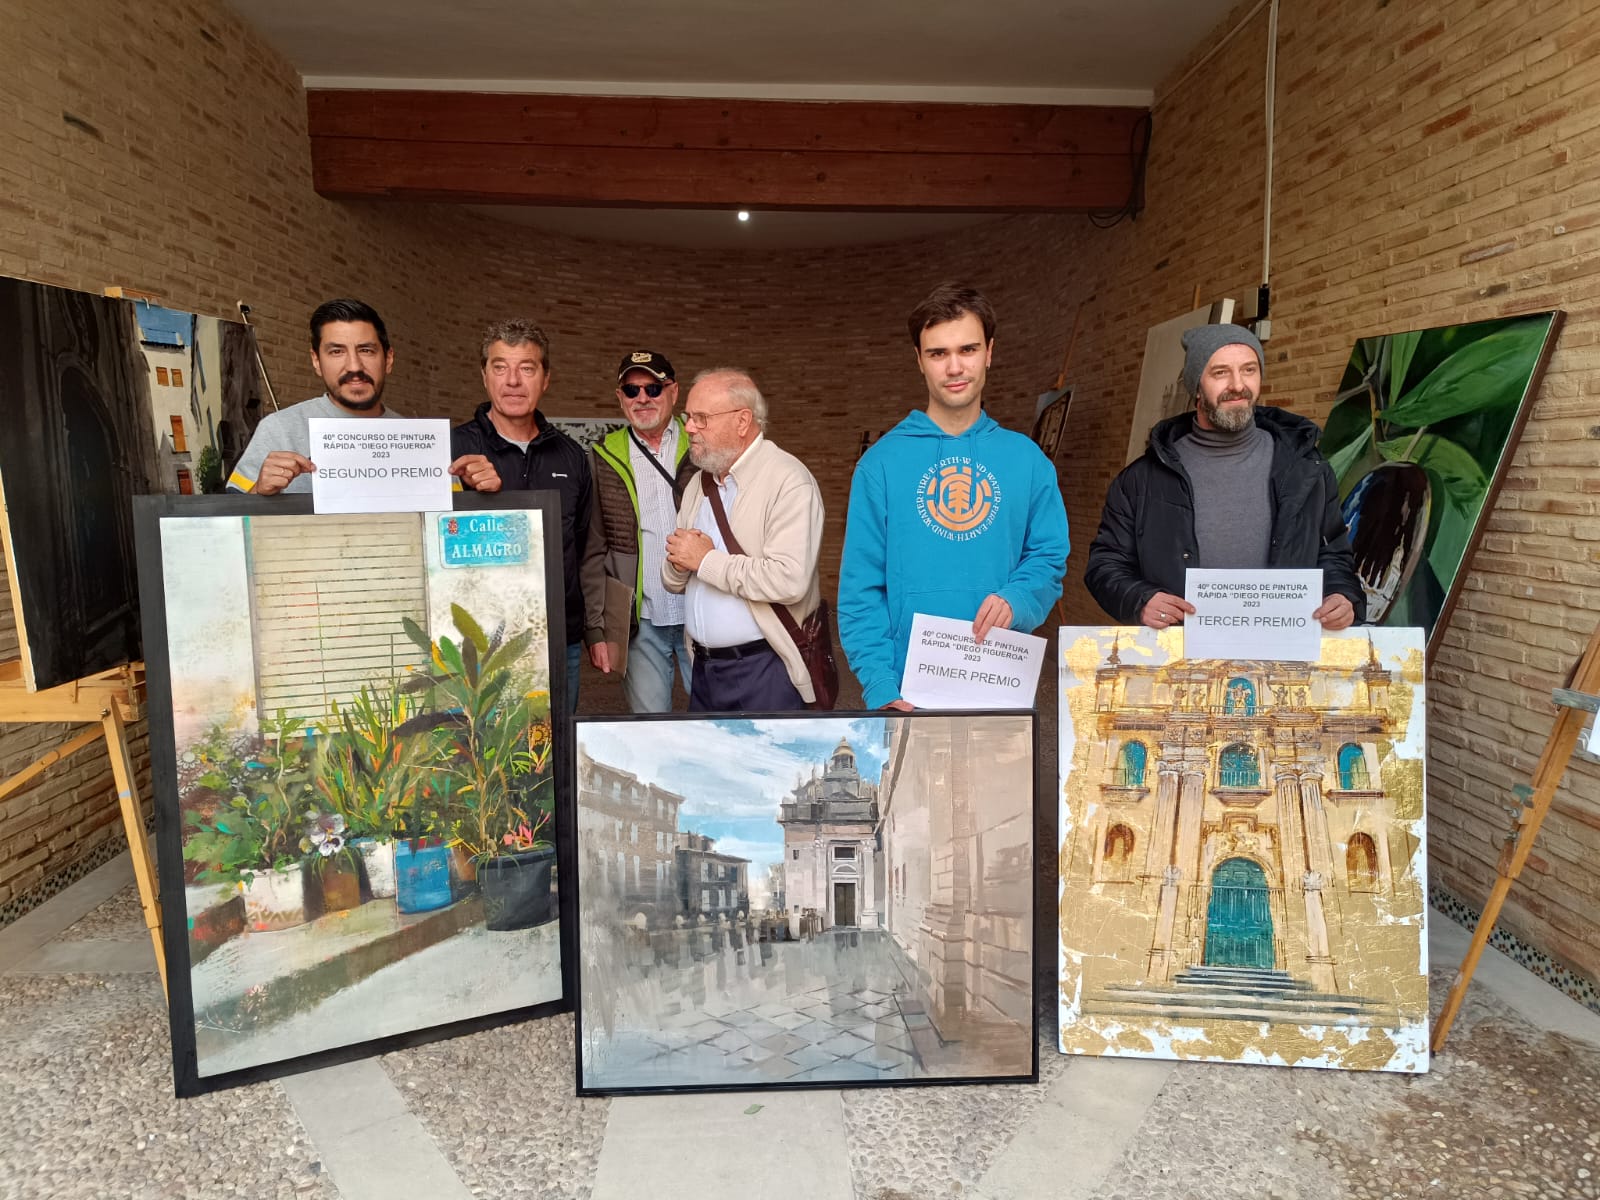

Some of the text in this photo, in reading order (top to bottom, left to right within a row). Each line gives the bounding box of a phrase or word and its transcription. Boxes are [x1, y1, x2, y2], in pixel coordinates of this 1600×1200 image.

[337, 433, 386, 441] CONCURSO
[387, 433, 398, 441] DE
[401, 433, 436, 441] PINTURA
[323, 442, 355, 450] RÁPIDA
[319, 467, 443, 479] SEGUNDO PREMIO
[962, 457, 987, 473] WND
[916, 472, 931, 494] FIRE
[987, 472, 1002, 503] WATER
[916, 496, 932, 527] WATER
[988, 505, 1000, 527] FIRE
[469, 518, 503, 532] Calle
[931, 524, 954, 541] WIND
[957, 524, 988, 541] EARTH
[452, 543, 522, 559] ALMAGRO
[1197, 615, 1306, 628] TERCER PREMIO
[921, 638, 950, 649] RÁPIDA
[936, 632, 979, 644] CONCURS
[994, 641, 1029, 654] PINTURA
[963, 654, 981, 662] 2023
[918, 663, 1021, 688] PRIMER PREMIO
